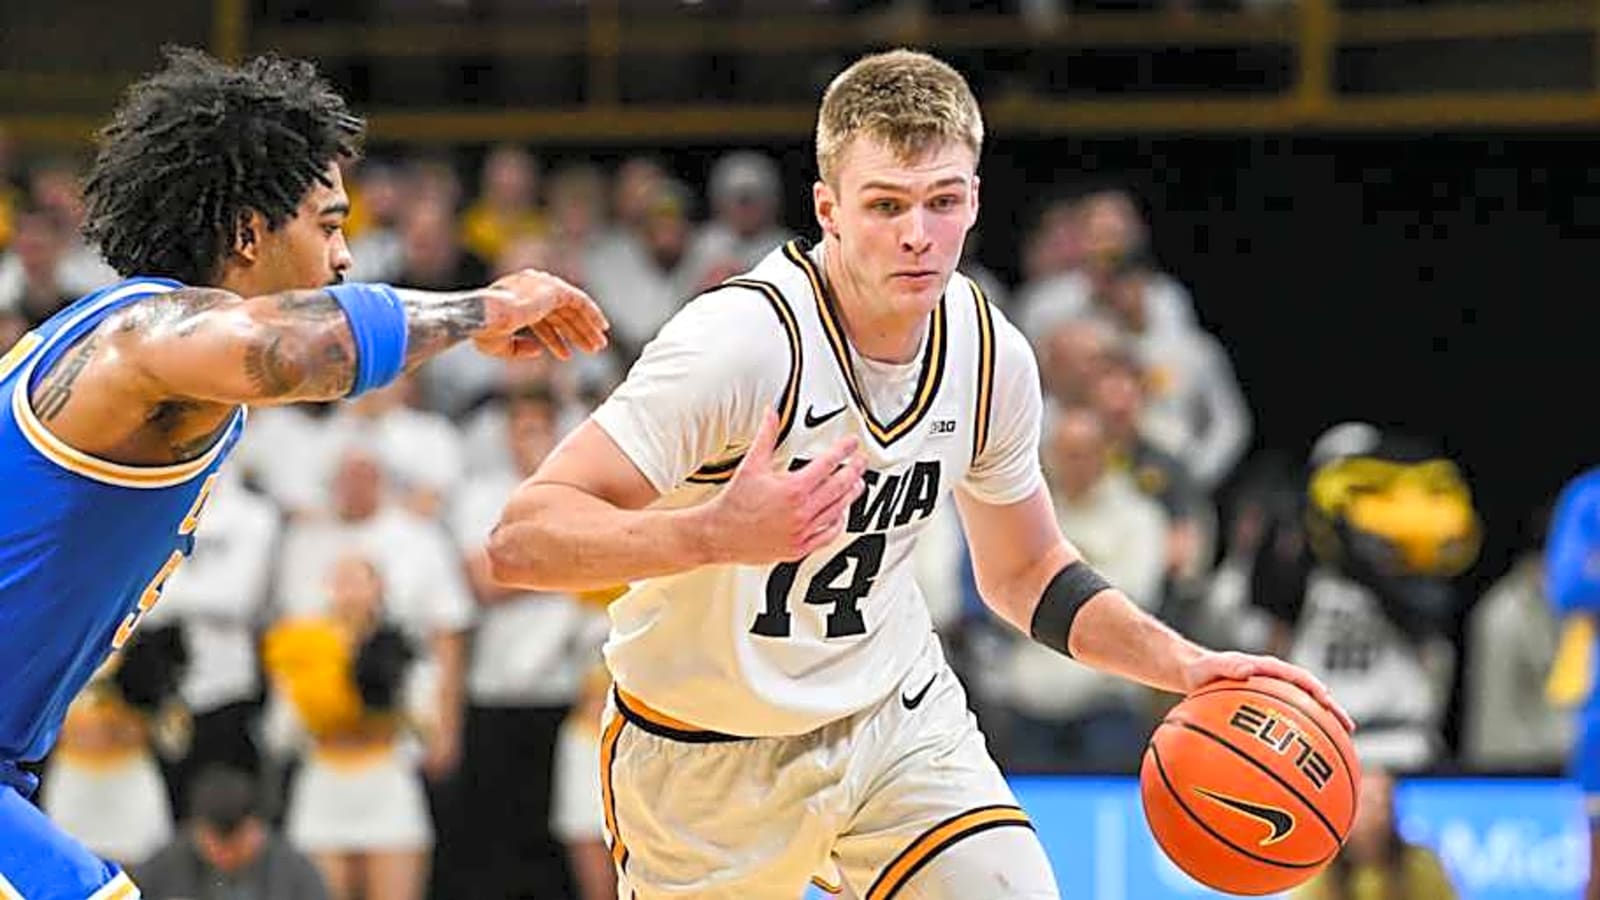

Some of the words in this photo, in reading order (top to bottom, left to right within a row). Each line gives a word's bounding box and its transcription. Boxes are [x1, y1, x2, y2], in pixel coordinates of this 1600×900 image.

[788, 458, 941, 533] WA
[749, 533, 887, 638] 14
[1230, 704, 1334, 790] ELITE
